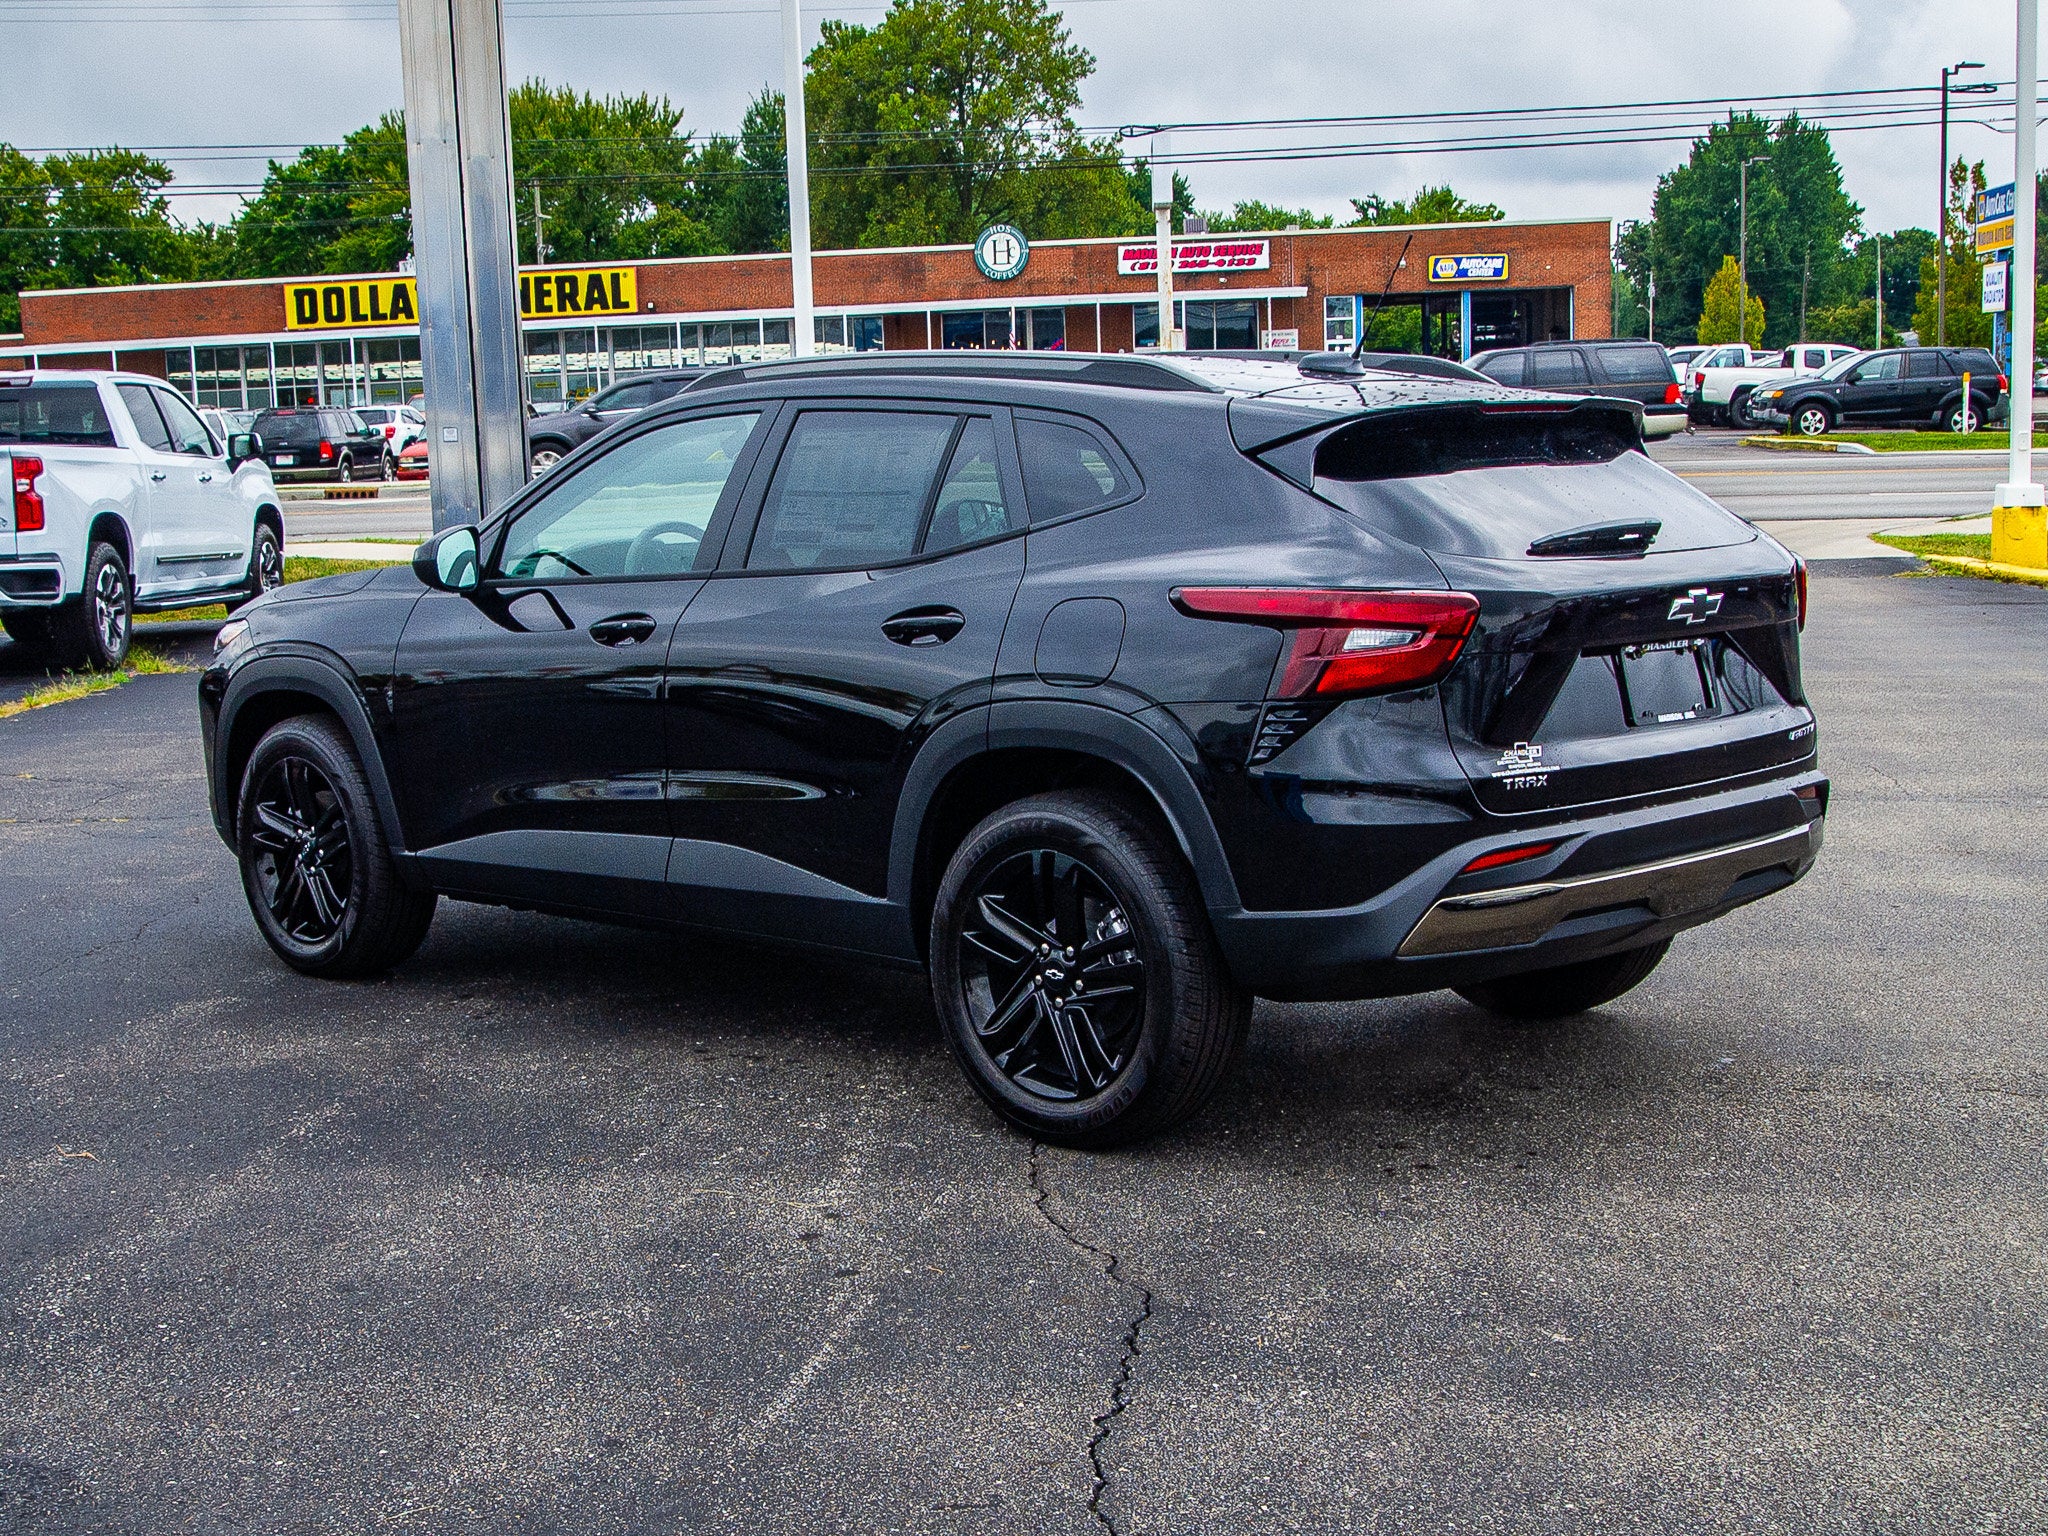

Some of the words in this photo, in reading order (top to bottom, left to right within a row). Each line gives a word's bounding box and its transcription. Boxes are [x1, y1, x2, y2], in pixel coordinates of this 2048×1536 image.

[989, 224, 1012, 234] HOS
[1179, 245, 1211, 258] AUTO
[1213, 243, 1264, 257] SERVICE
[984, 266, 1019, 280] COFFEE
[293, 283, 418, 325] DOLLA
[1642, 640, 1689, 651] CHANDLER
[1502, 774, 1548, 790] TRAX
